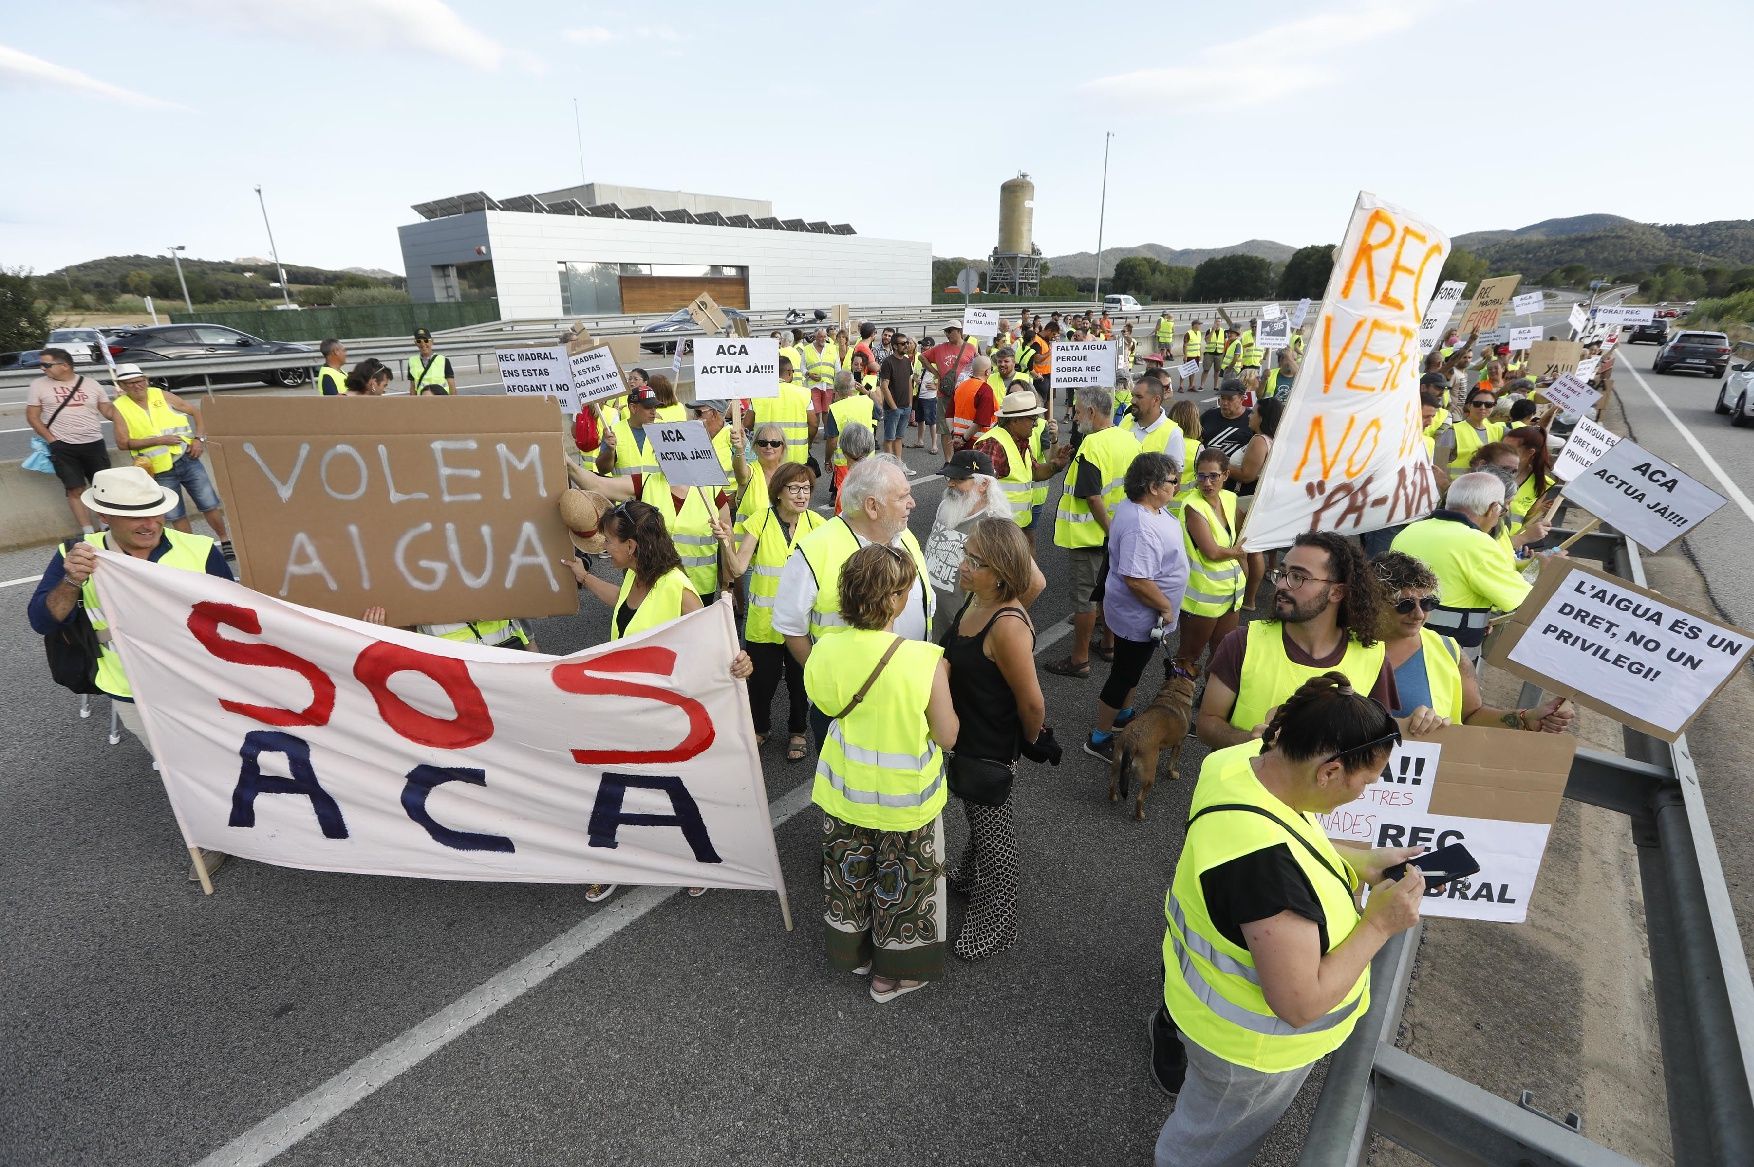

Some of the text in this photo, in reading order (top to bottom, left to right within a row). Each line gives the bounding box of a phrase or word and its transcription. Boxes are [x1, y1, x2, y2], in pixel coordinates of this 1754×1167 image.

[1340, 208, 1442, 326] REC
[1477, 285, 1496, 300] REC
[1422, 319, 1437, 329] REC
[1463, 308, 1499, 332] FORA
[498, 352, 558, 362] REC MADRAL,
[573, 352, 606, 366] MADRAL,
[716, 344, 749, 356] ACA
[1056, 344, 1079, 352] FALTA
[502, 368, 550, 378] ENS ESTAS
[577, 364, 601, 376] ESTAS
[701, 363, 774, 374] ACTUA JÀ!!!!
[507, 384, 547, 393] AFOGANT
[556, 383, 570, 392] NO
[575, 376, 600, 389] OGANT
[606, 371, 618, 379] NO
[660, 429, 686, 442] ACA
[1580, 421, 1604, 442] L'AIGUA
[660, 451, 689, 461] ACTUA
[1292, 414, 1382, 482] NO
[1573, 435, 1602, 457] DRET, NO
[243, 439, 549, 504] VOLEM
[1632, 462, 1679, 494] ACA
[1593, 469, 1689, 528] ACTUA JÀ!!!!
[278, 521, 561, 597] AIGUA
[1573, 580, 1743, 656] L'AIGUA ÉS UN
[1557, 602, 1704, 670] DRET, NO UN
[1542, 623, 1663, 682] PRIVILEGI!
[187, 600, 716, 765] SOS
[1380, 755, 1426, 786] A!!
[228, 729, 723, 864] ACA
[1377, 823, 1465, 853] REC
